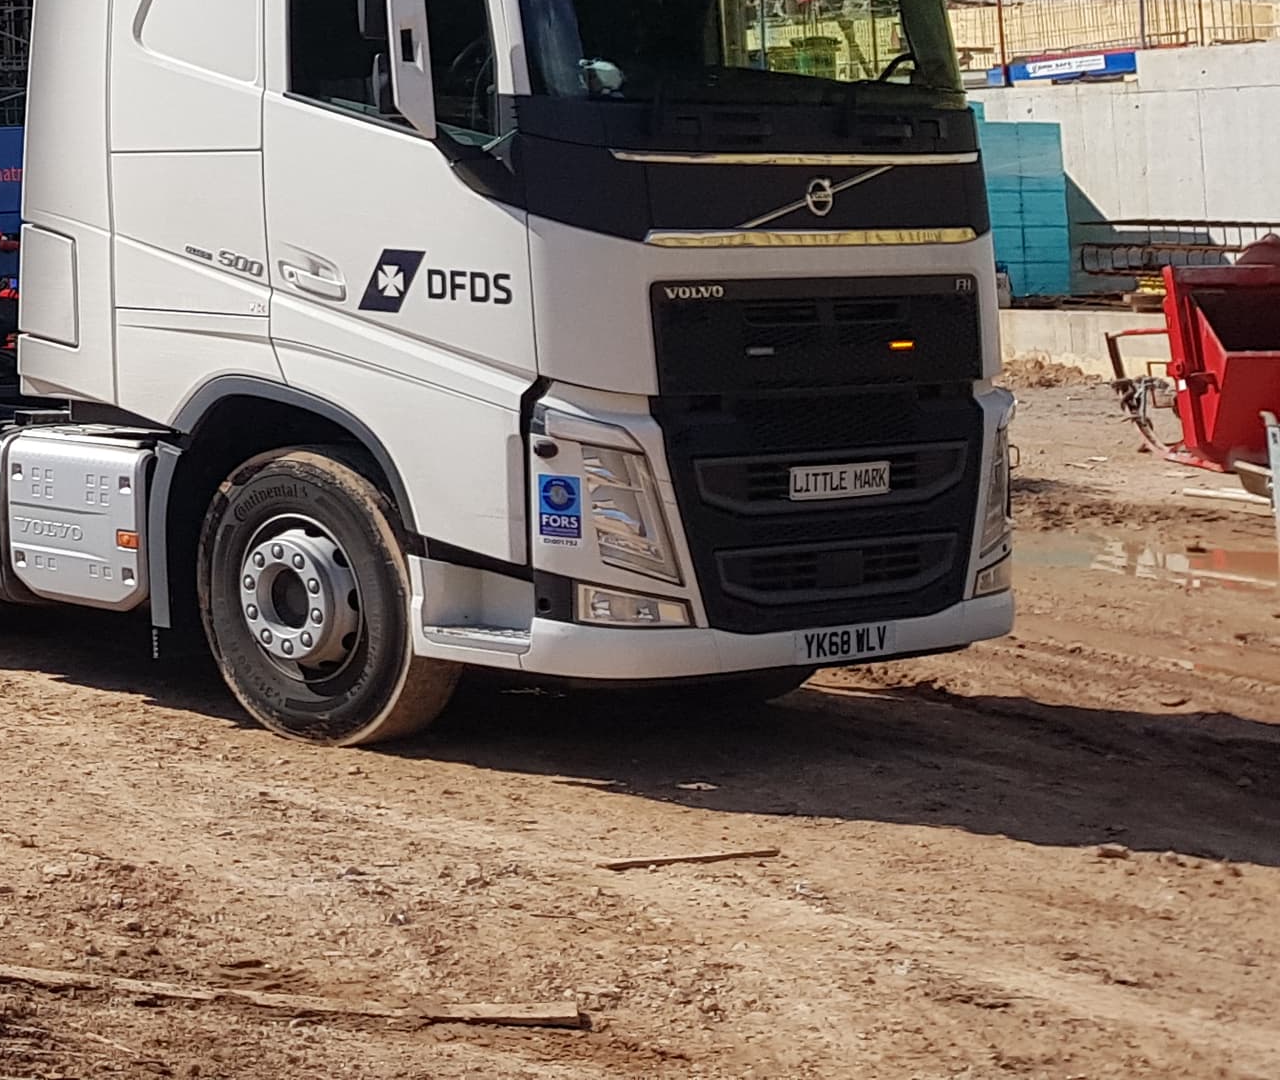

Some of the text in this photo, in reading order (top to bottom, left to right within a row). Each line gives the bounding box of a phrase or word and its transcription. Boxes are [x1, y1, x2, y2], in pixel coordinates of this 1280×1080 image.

[218, 249, 264, 277] 500
[427, 268, 513, 305] DFDS
[663, 285, 724, 299] VOLVO
[793, 467, 887, 493] LITTLE MARK
[234, 483, 298, 522] Continental
[13, 516, 83, 541] VOLVO
[542, 514, 578, 528] FORS
[804, 625, 887, 659] YK68 WLV
